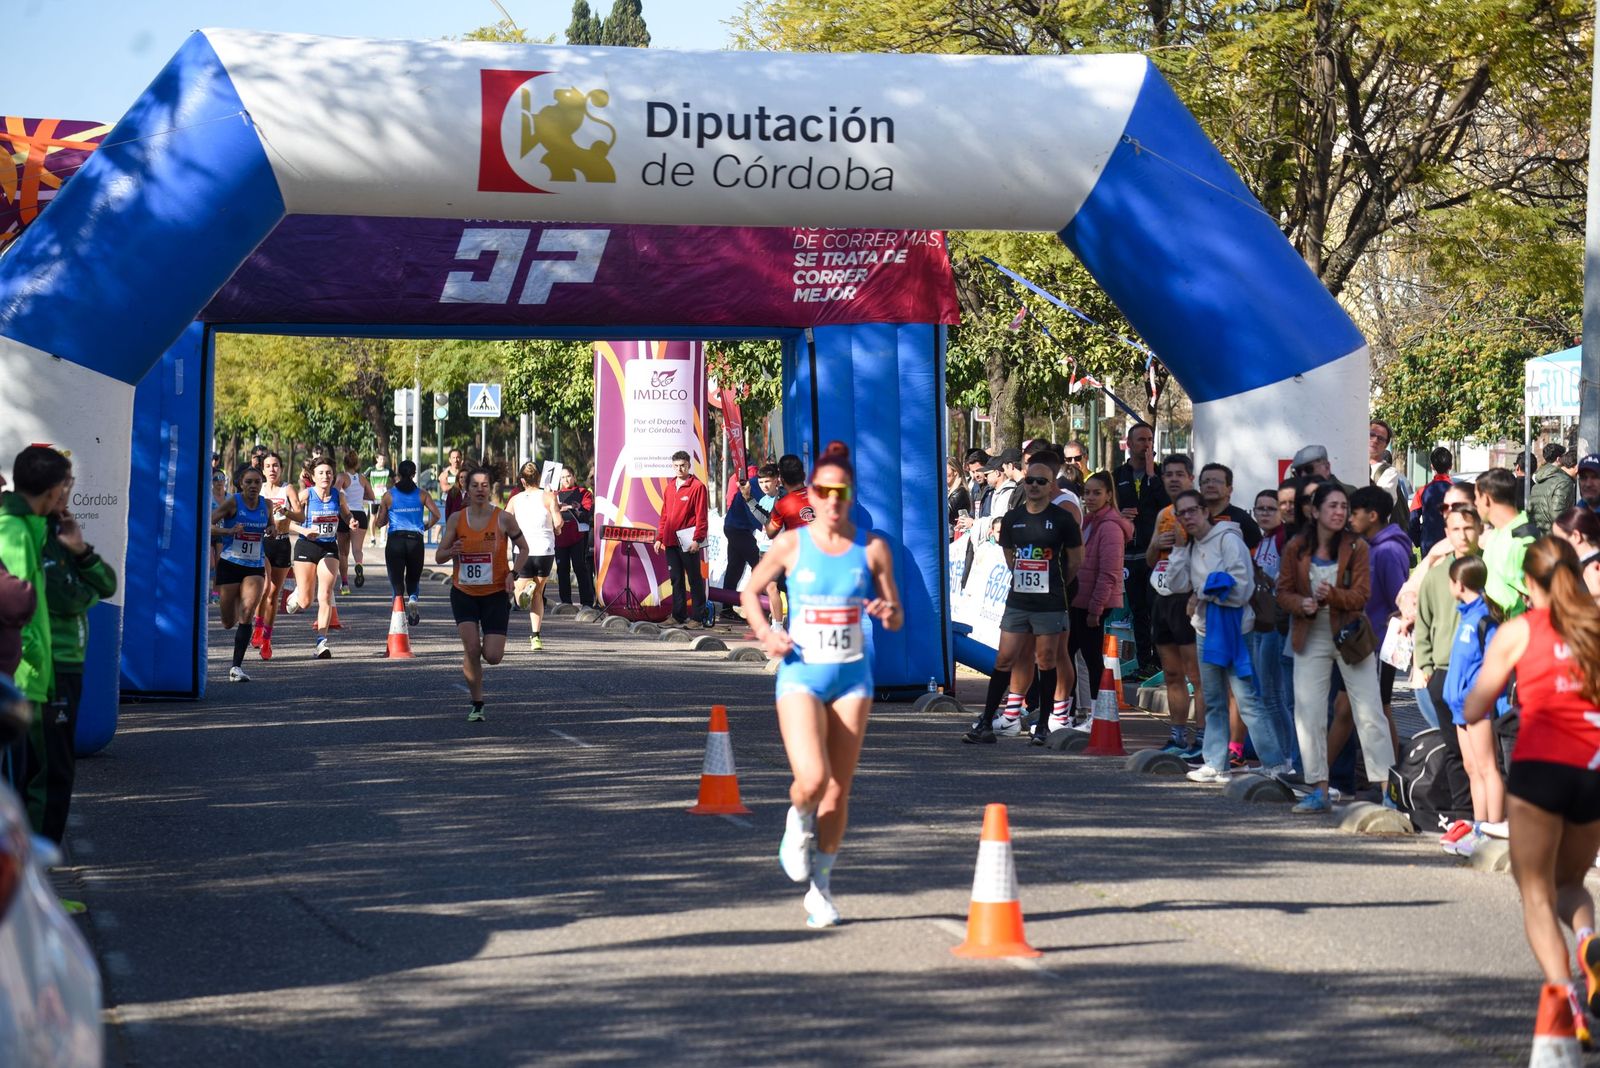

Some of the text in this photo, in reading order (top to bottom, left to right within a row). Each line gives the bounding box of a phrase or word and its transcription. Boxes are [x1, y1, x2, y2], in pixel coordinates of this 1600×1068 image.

[646, 101, 895, 149] Diputación
[641, 152, 895, 192] de Córdoba
[793, 234, 819, 249] DE
[823, 233, 898, 249] CORRER
[793, 249, 908, 267] SE TRATA DE
[793, 268, 869, 285] CORRER
[793, 286, 857, 303] MEJOR
[633, 389, 688, 400] IMDECO
[656, 418, 688, 427] Deporte.
[72, 492, 118, 506] Córdoba
[74, 512, 99, 520] portes
[318, 523, 334, 534] 156
[241, 542, 253, 554] 91
[467, 564, 482, 579] 86
[1020, 572, 1040, 586] 153
[819, 628, 851, 650] 145
